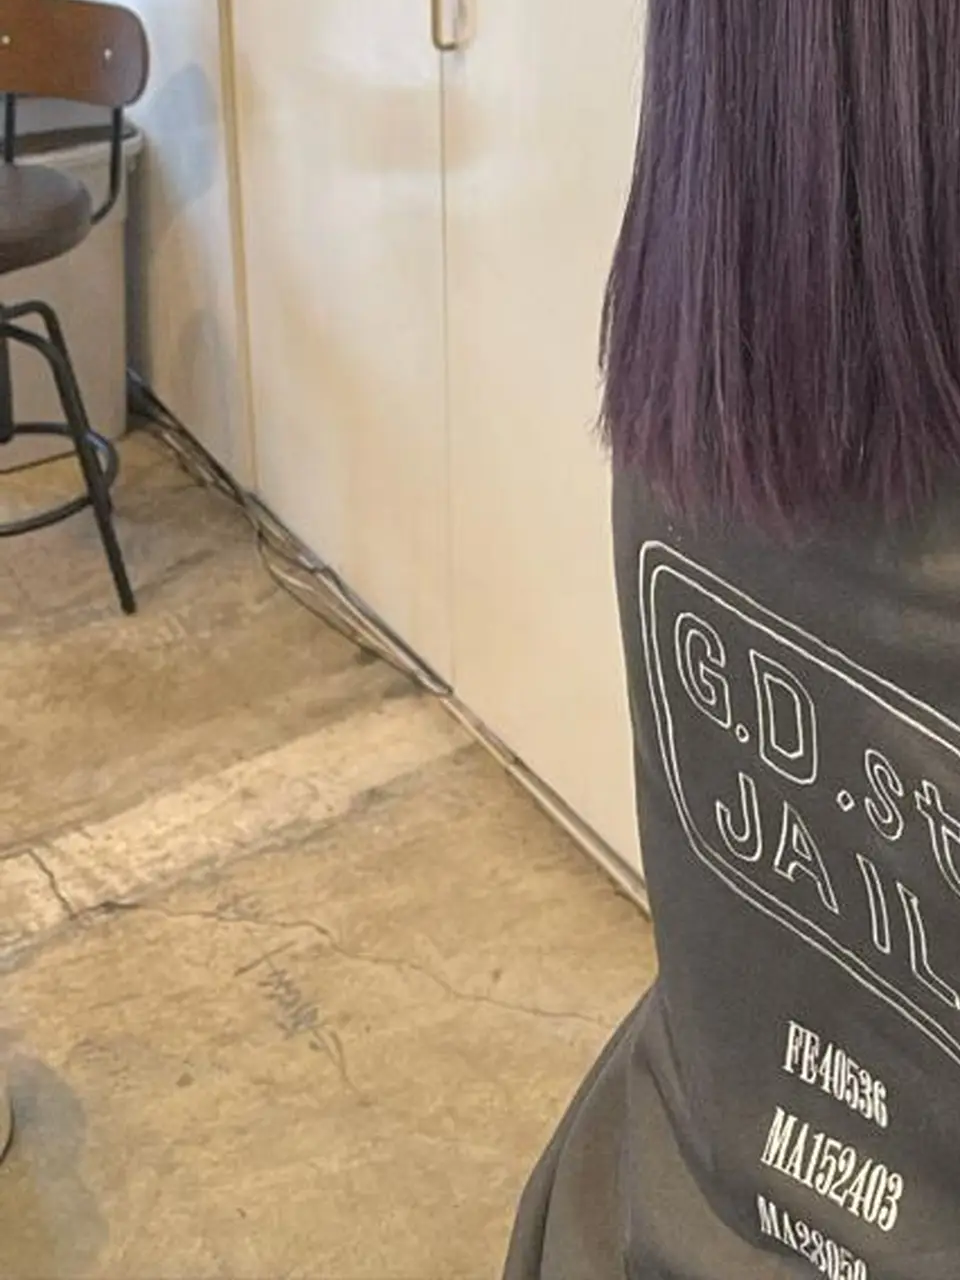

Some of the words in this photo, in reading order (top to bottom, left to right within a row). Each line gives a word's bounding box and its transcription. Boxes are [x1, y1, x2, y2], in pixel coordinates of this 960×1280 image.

[715, 773, 960, 1010] JAIL
[782, 1020, 889, 1128] FE40536
[760, 1106, 904, 1232] MA152403
